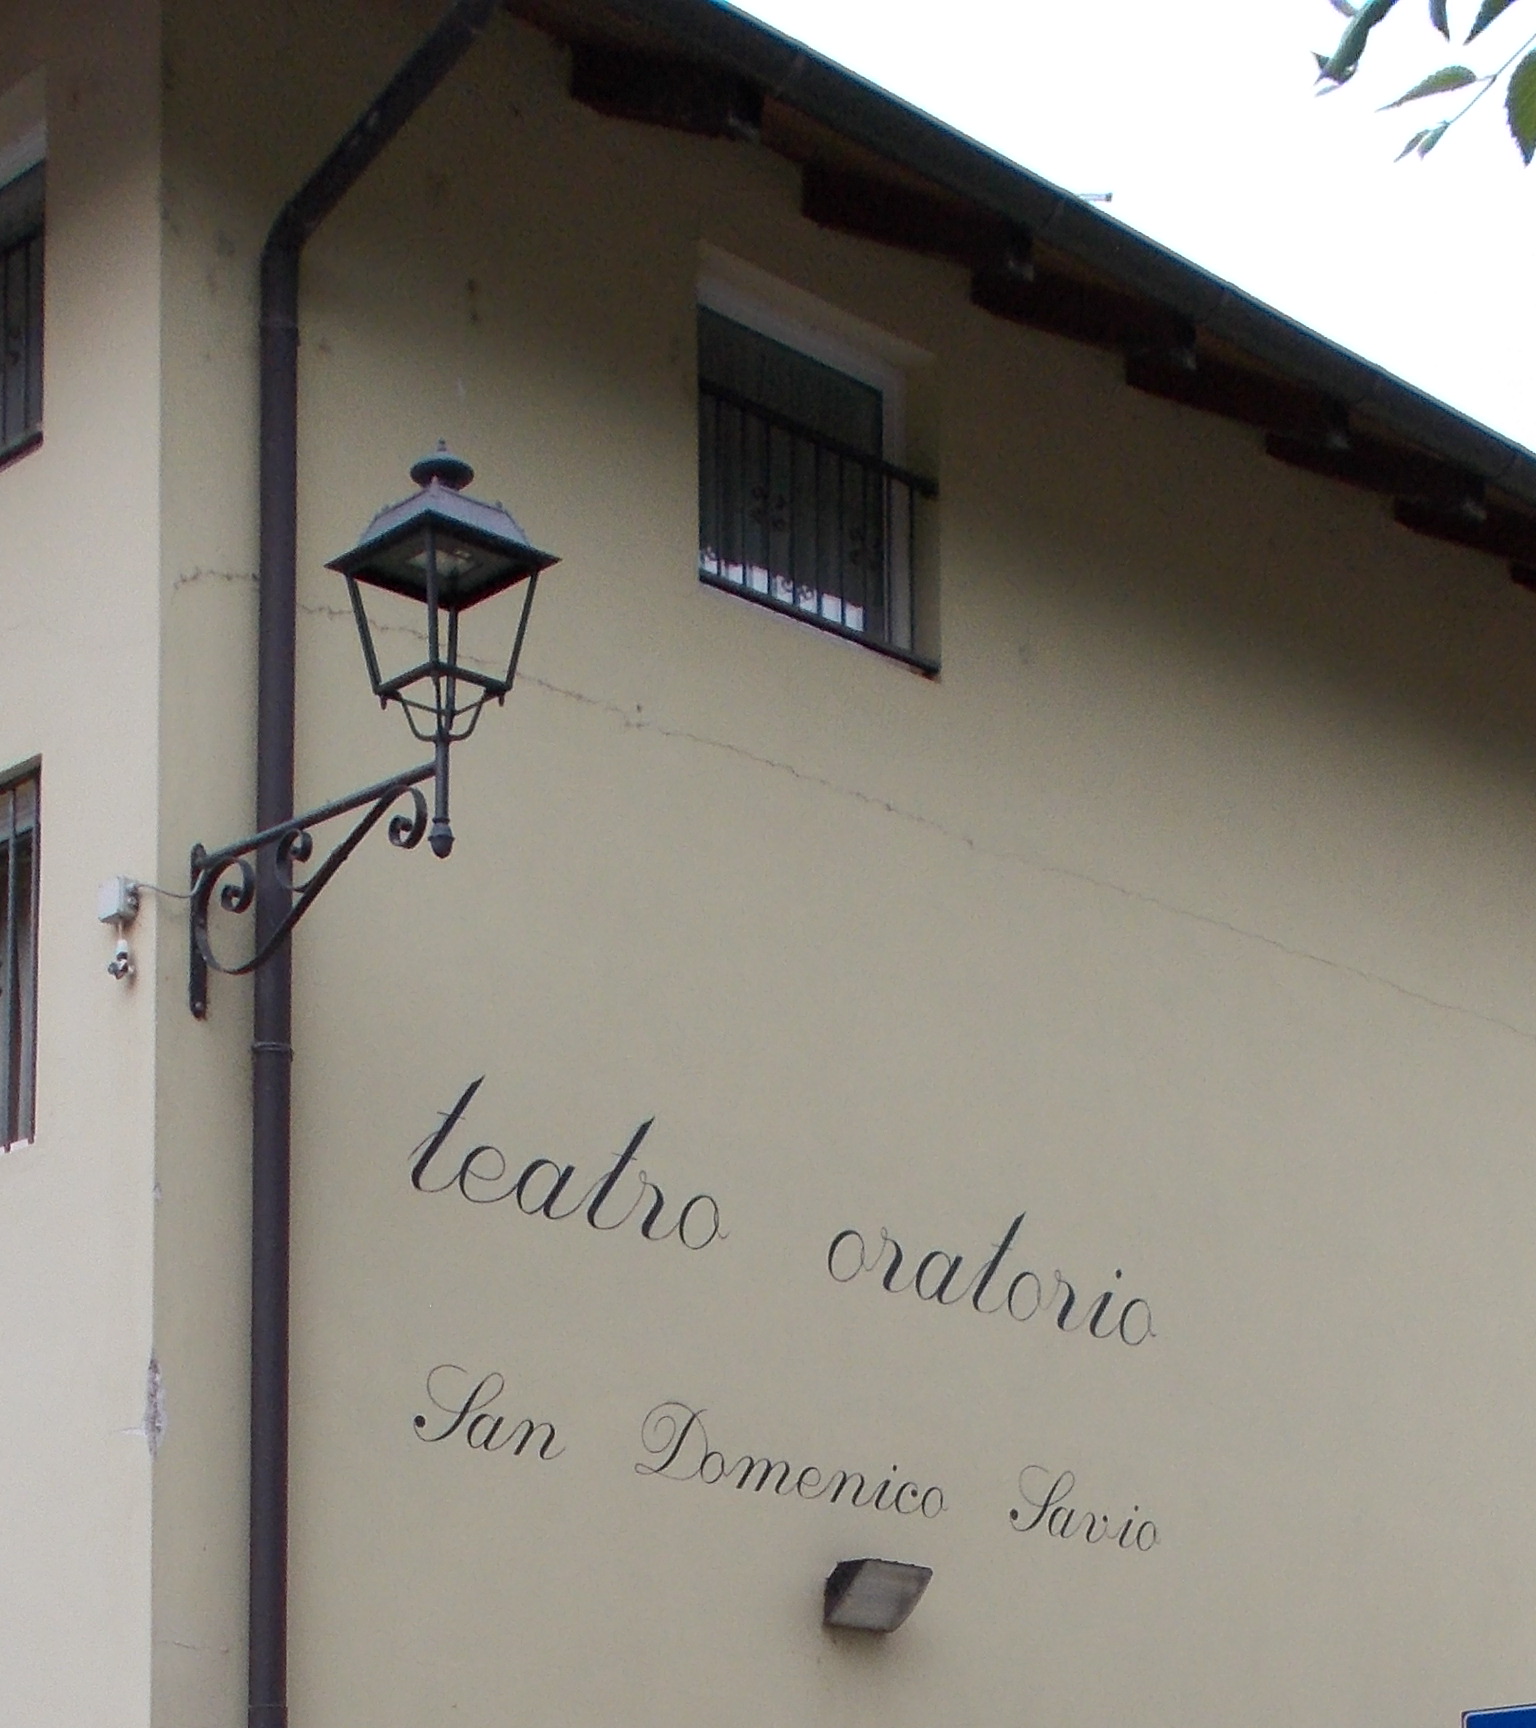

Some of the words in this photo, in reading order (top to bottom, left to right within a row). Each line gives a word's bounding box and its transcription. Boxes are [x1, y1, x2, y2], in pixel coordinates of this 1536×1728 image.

[407, 1074, 730, 1250] teatro
[826, 1210, 1157, 1348] oratorio
[413, 1363, 566, 1461] San
[634, 1401, 949, 1520] Domenico
[1009, 1464, 1161, 1552] Savio
